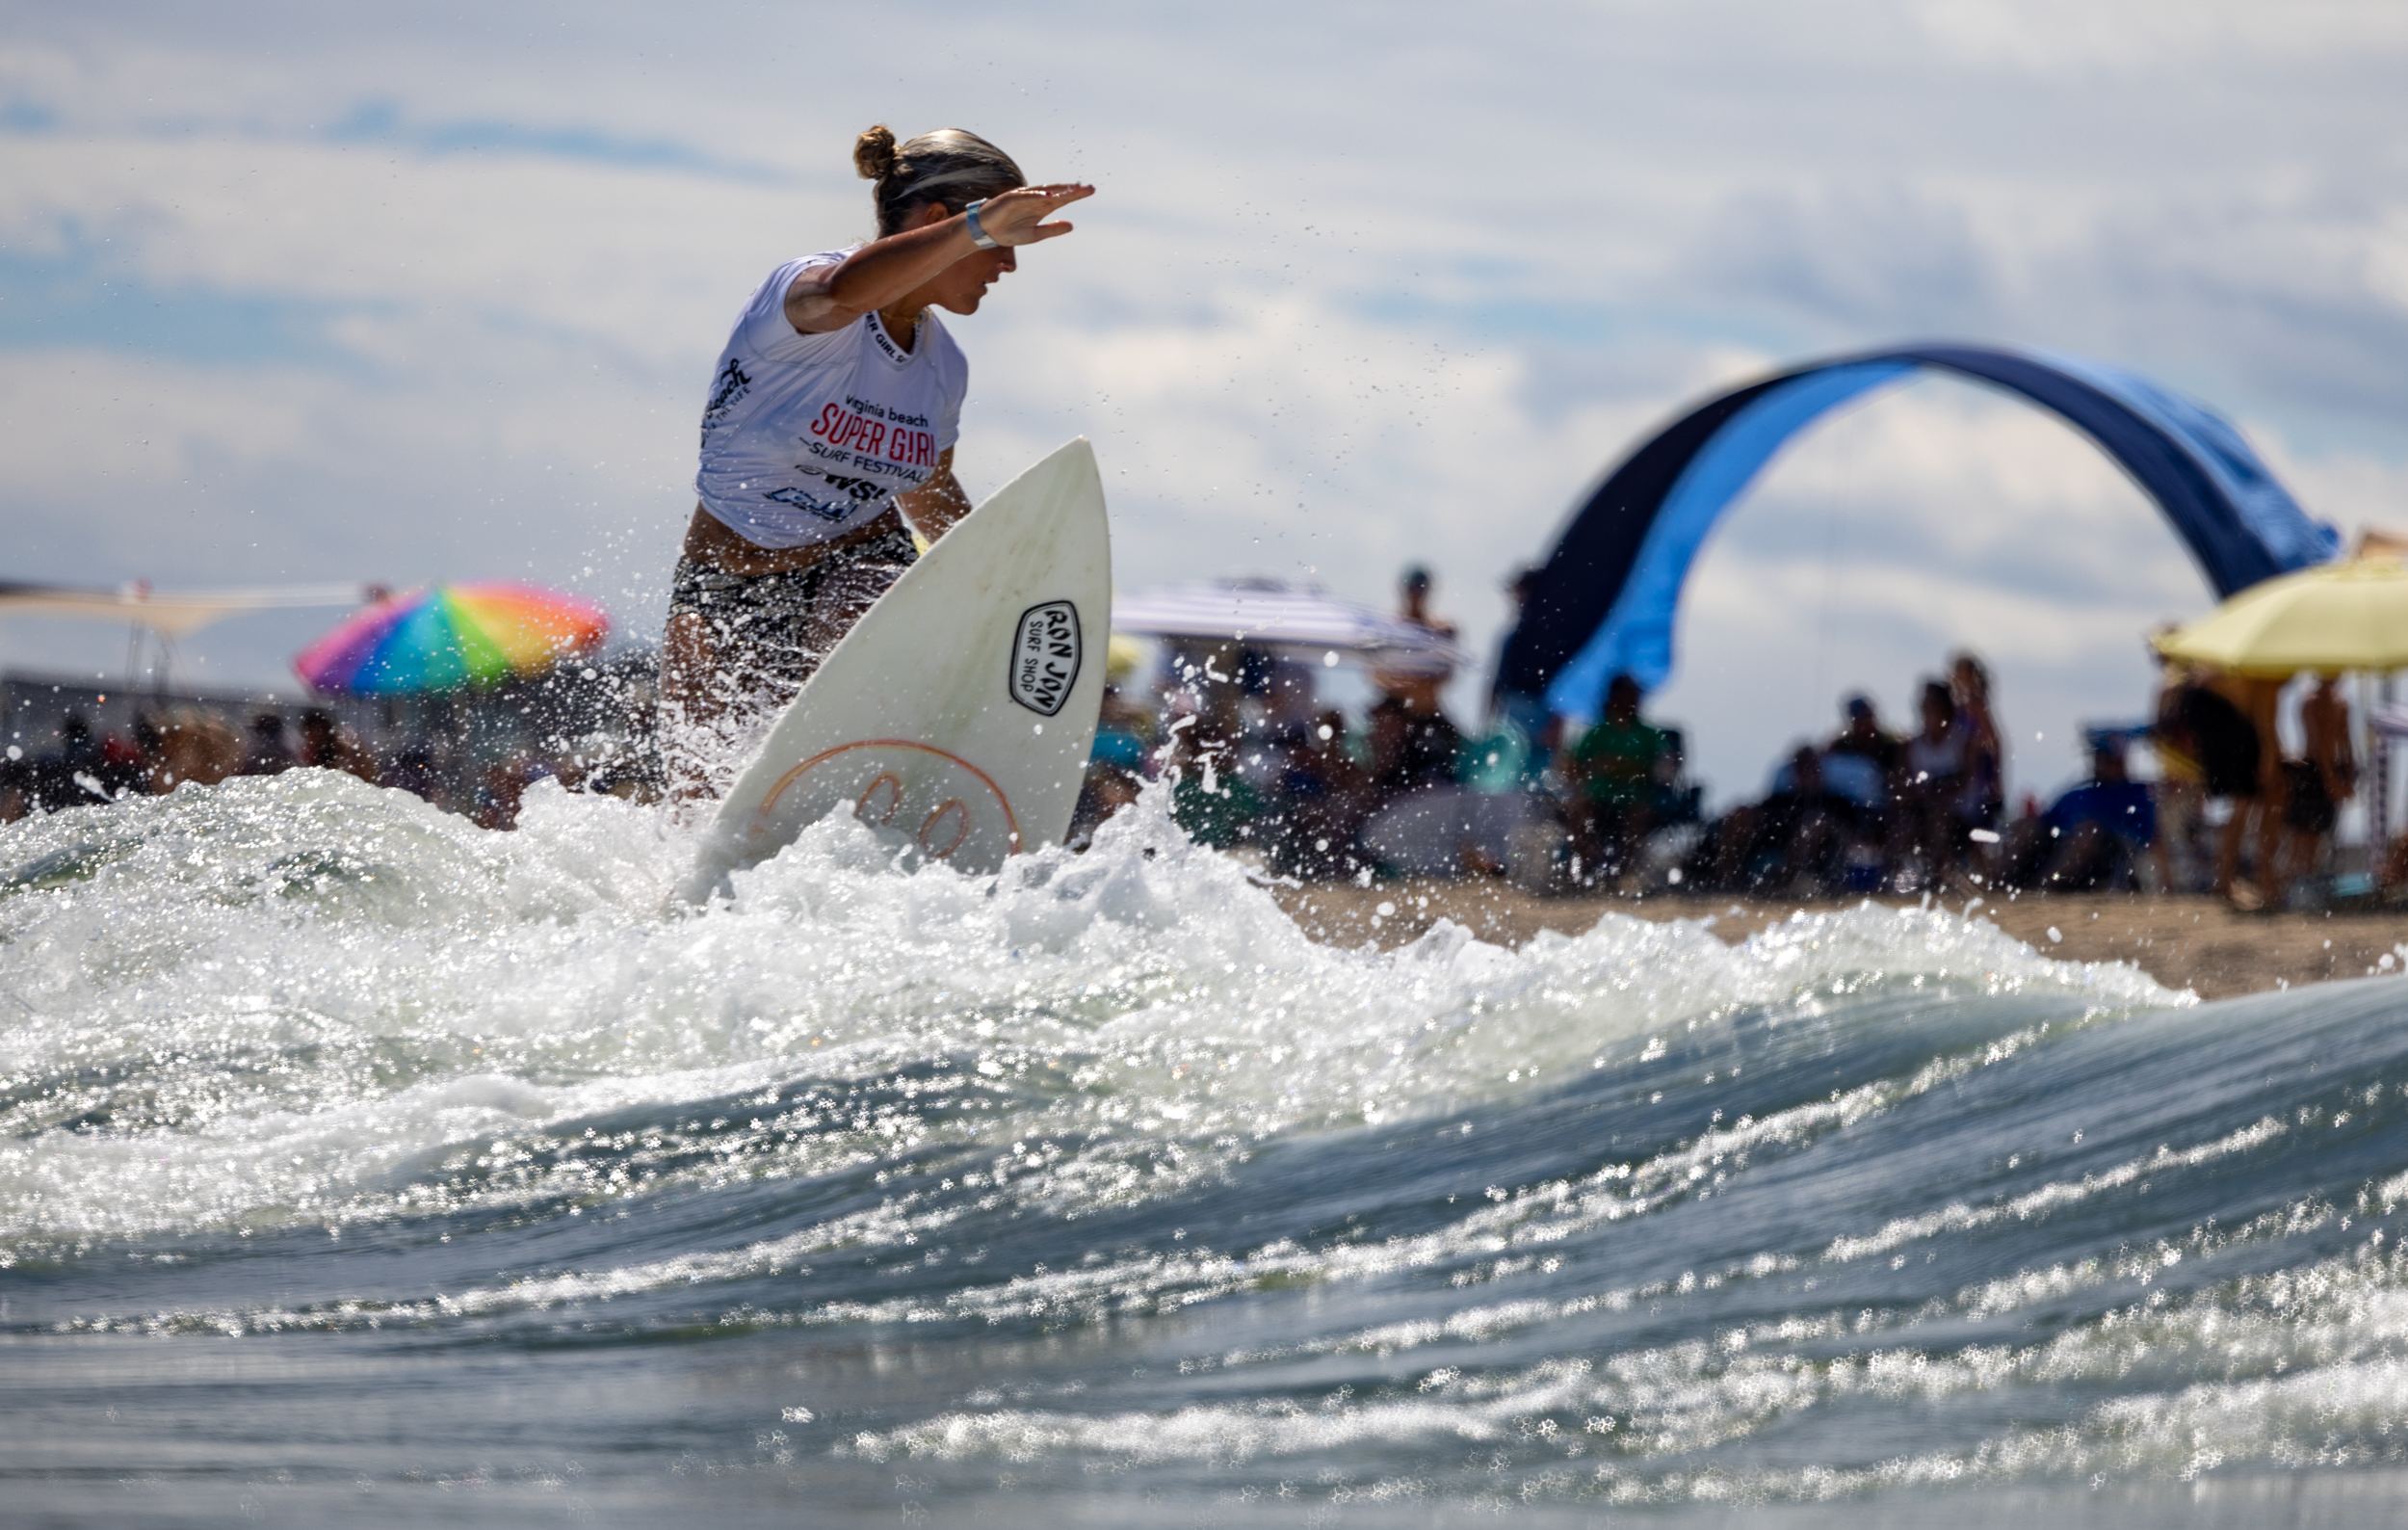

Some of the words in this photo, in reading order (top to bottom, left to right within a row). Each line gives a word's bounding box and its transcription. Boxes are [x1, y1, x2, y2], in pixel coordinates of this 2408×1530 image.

[876, 333, 896, 358] GIRL
[731, 385, 751, 406] LIFE
[845, 394, 885, 418] virginia
[888, 408, 929, 427] beach
[811, 402, 885, 456] SUPER
[889, 427, 935, 467] GIRL
[808, 441, 851, 462] SURF
[853, 456, 925, 483] FESTIVAL
[1027, 620, 1043, 652] SURF
[1043, 610, 1073, 658] RON
[1020, 658, 1038, 693] SHOP
[1033, 662, 1067, 709] JON
